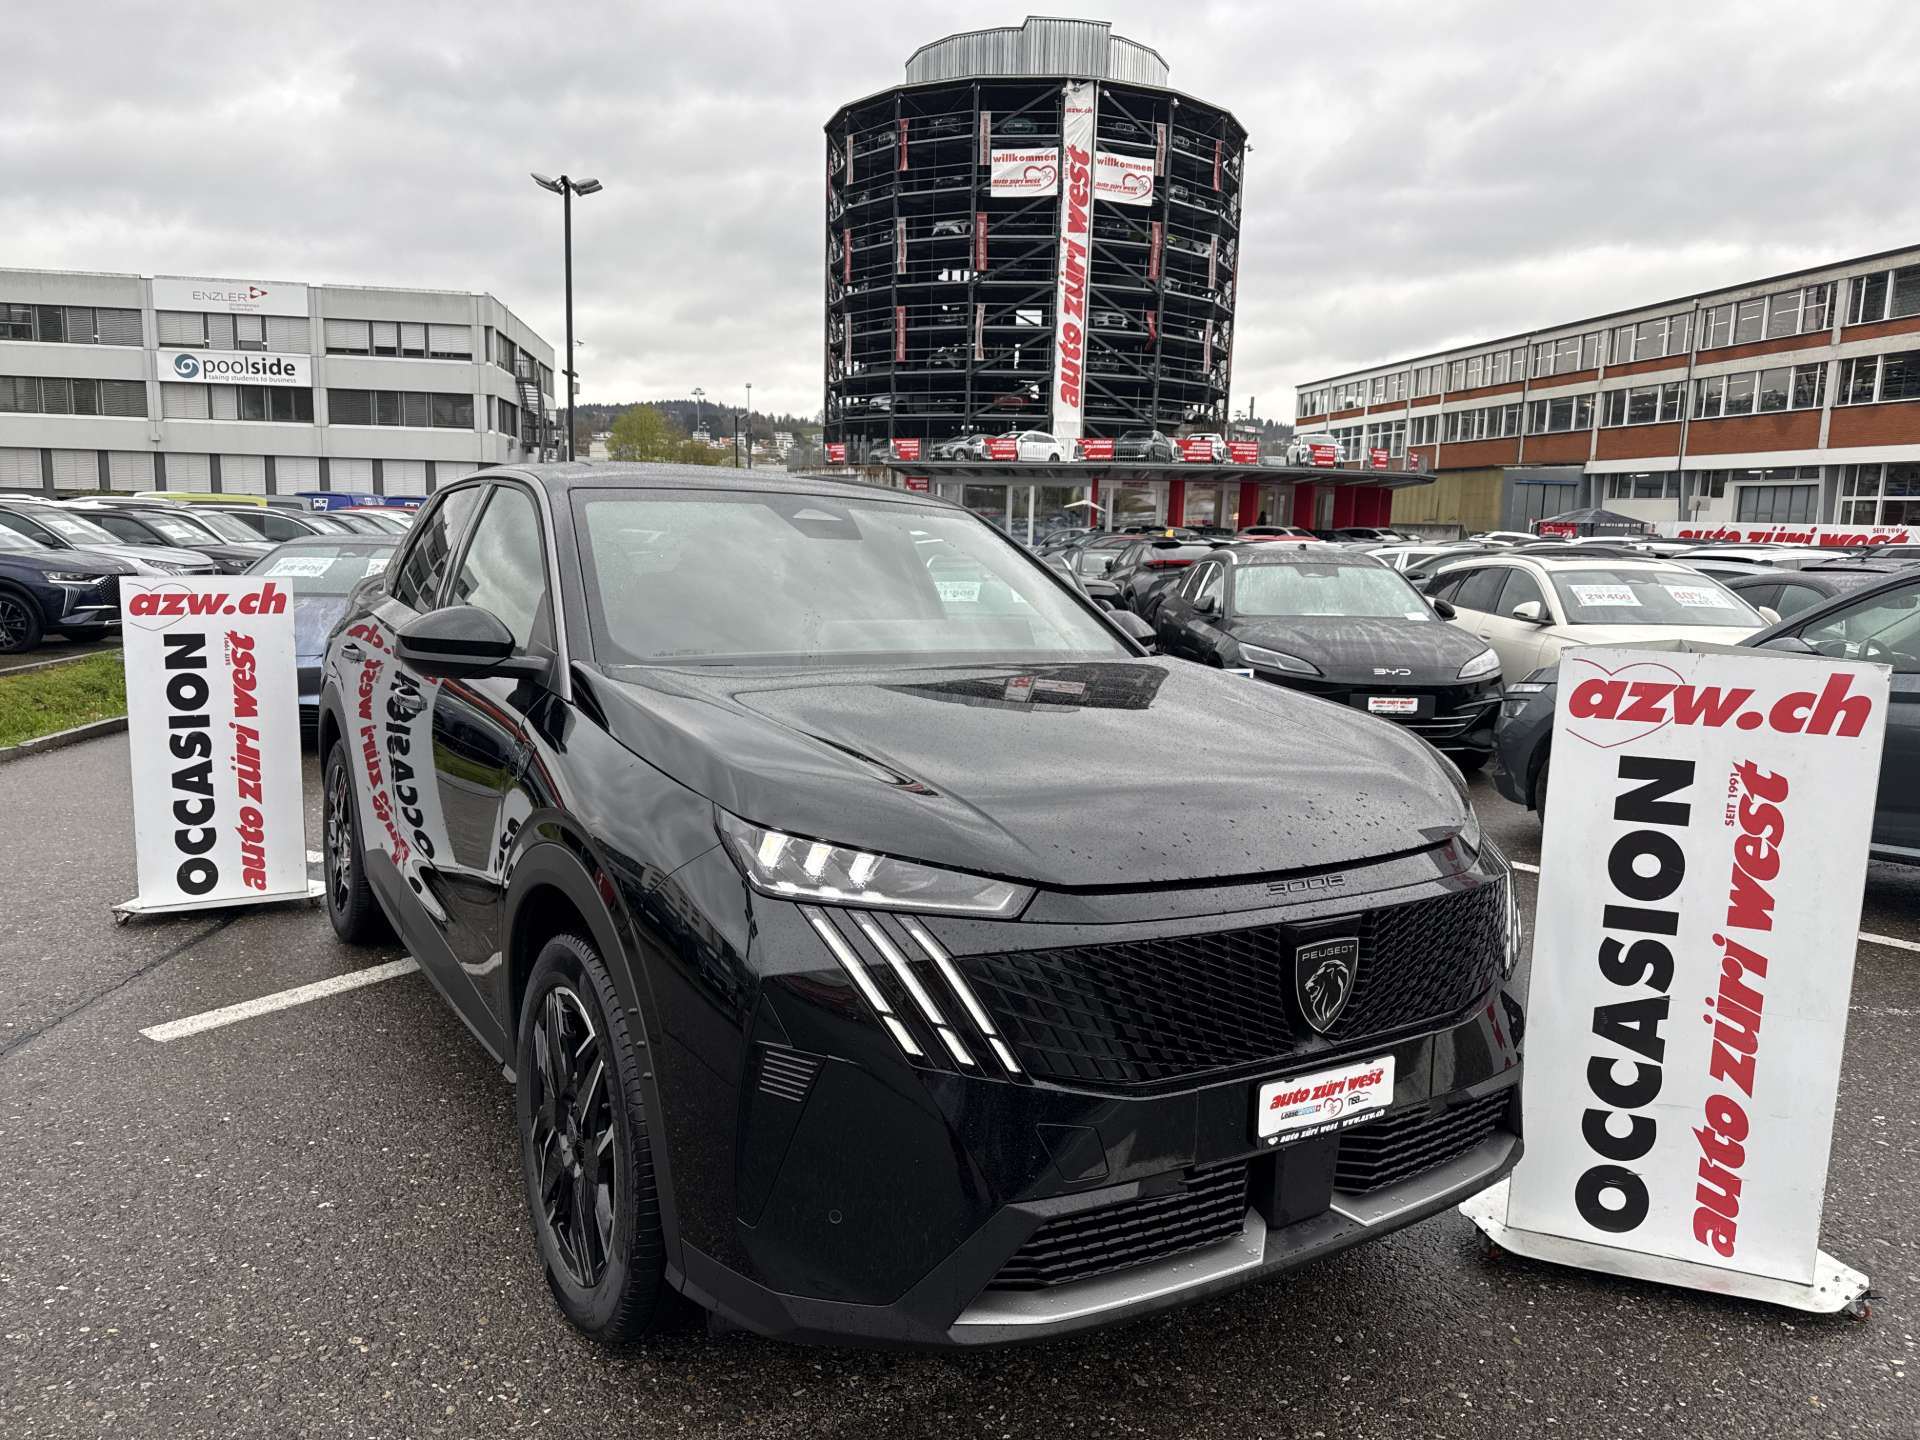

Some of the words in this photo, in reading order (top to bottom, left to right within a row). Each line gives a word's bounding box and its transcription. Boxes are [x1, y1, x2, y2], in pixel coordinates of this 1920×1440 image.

[992, 153, 1057, 164] willkommen
[1096, 157, 1153, 172] willkommen
[1067, 144, 1091, 234] west
[192, 290, 248, 302] ENZLER
[1060, 237, 1086, 320] züri
[203, 356, 296, 380] poolside
[208, 374, 230, 382] taking
[269, 376, 297, 384] business
[1058, 322, 1082, 408] auto
[129, 582, 288, 617] azw.ch
[226, 630, 258, 719] west
[1373, 668, 1412, 676] BYD
[1568, 672, 1873, 738] azw.ch
[163, 633, 219, 896] OCCASION
[229, 722, 264, 805] züri
[1727, 773, 1740, 799] 1991
[1725, 803, 1737, 827] SEIT
[233, 805, 267, 891] auto
[1726, 759, 1790, 932] west
[1266, 874, 1346, 896] 3008
[1301, 944, 1355, 962] PEUGEOT
[1574, 754, 1697, 1235] OCCASION
[1702, 932, 1769, 1099] züri
[1269, 1087, 1312, 1110] auto
[1311, 1076, 1348, 1101] züri
[1348, 1070, 1385, 1091] west
[1279, 1133, 1300, 1143] auto
[1300, 1126, 1320, 1139] züri
[1320, 1122, 1339, 1134] west
[1342, 1109, 1386, 1128] www.azw.ch
[1692, 1090, 1752, 1259] auto
